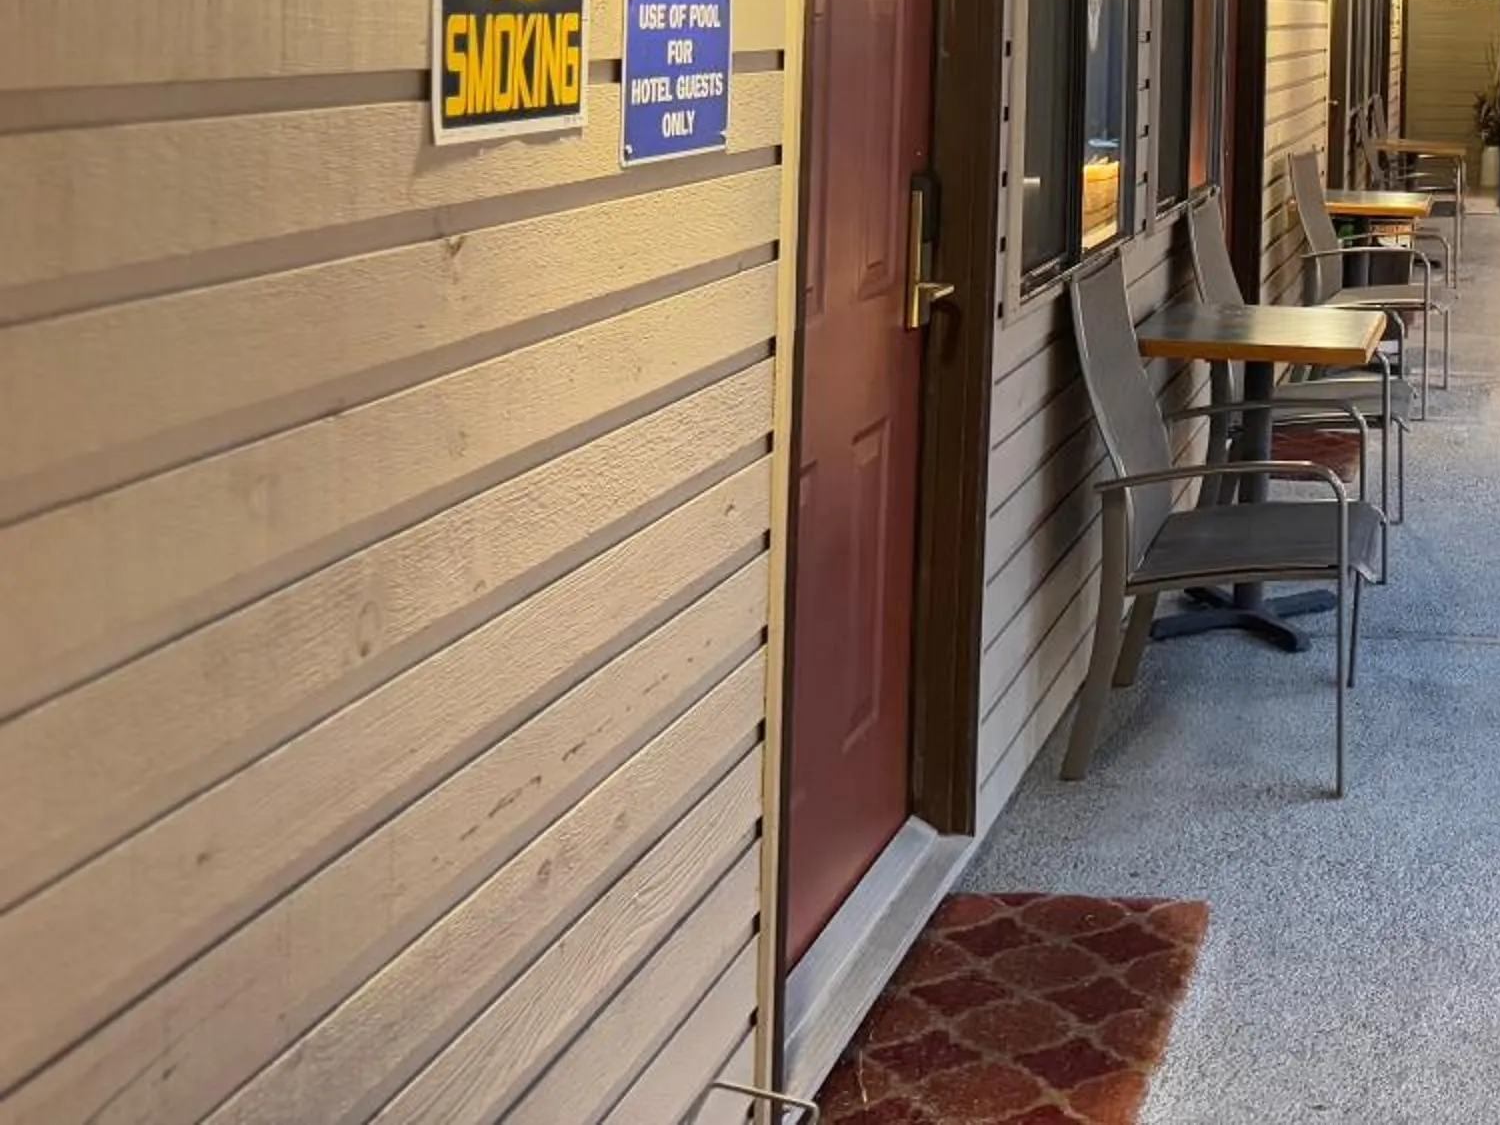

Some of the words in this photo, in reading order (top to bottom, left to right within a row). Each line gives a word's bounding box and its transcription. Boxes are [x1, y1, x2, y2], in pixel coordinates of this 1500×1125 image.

[639, 3, 666, 29] USE
[669, 4, 687, 28] OF
[690, 4, 721, 28] POOL
[445, 12, 579, 117] SMOKING
[667, 39, 693, 65] FOR
[631, 77, 672, 106] HOTEL
[676, 72, 724, 100] GUESTS
[661, 110, 696, 138] ONLY
